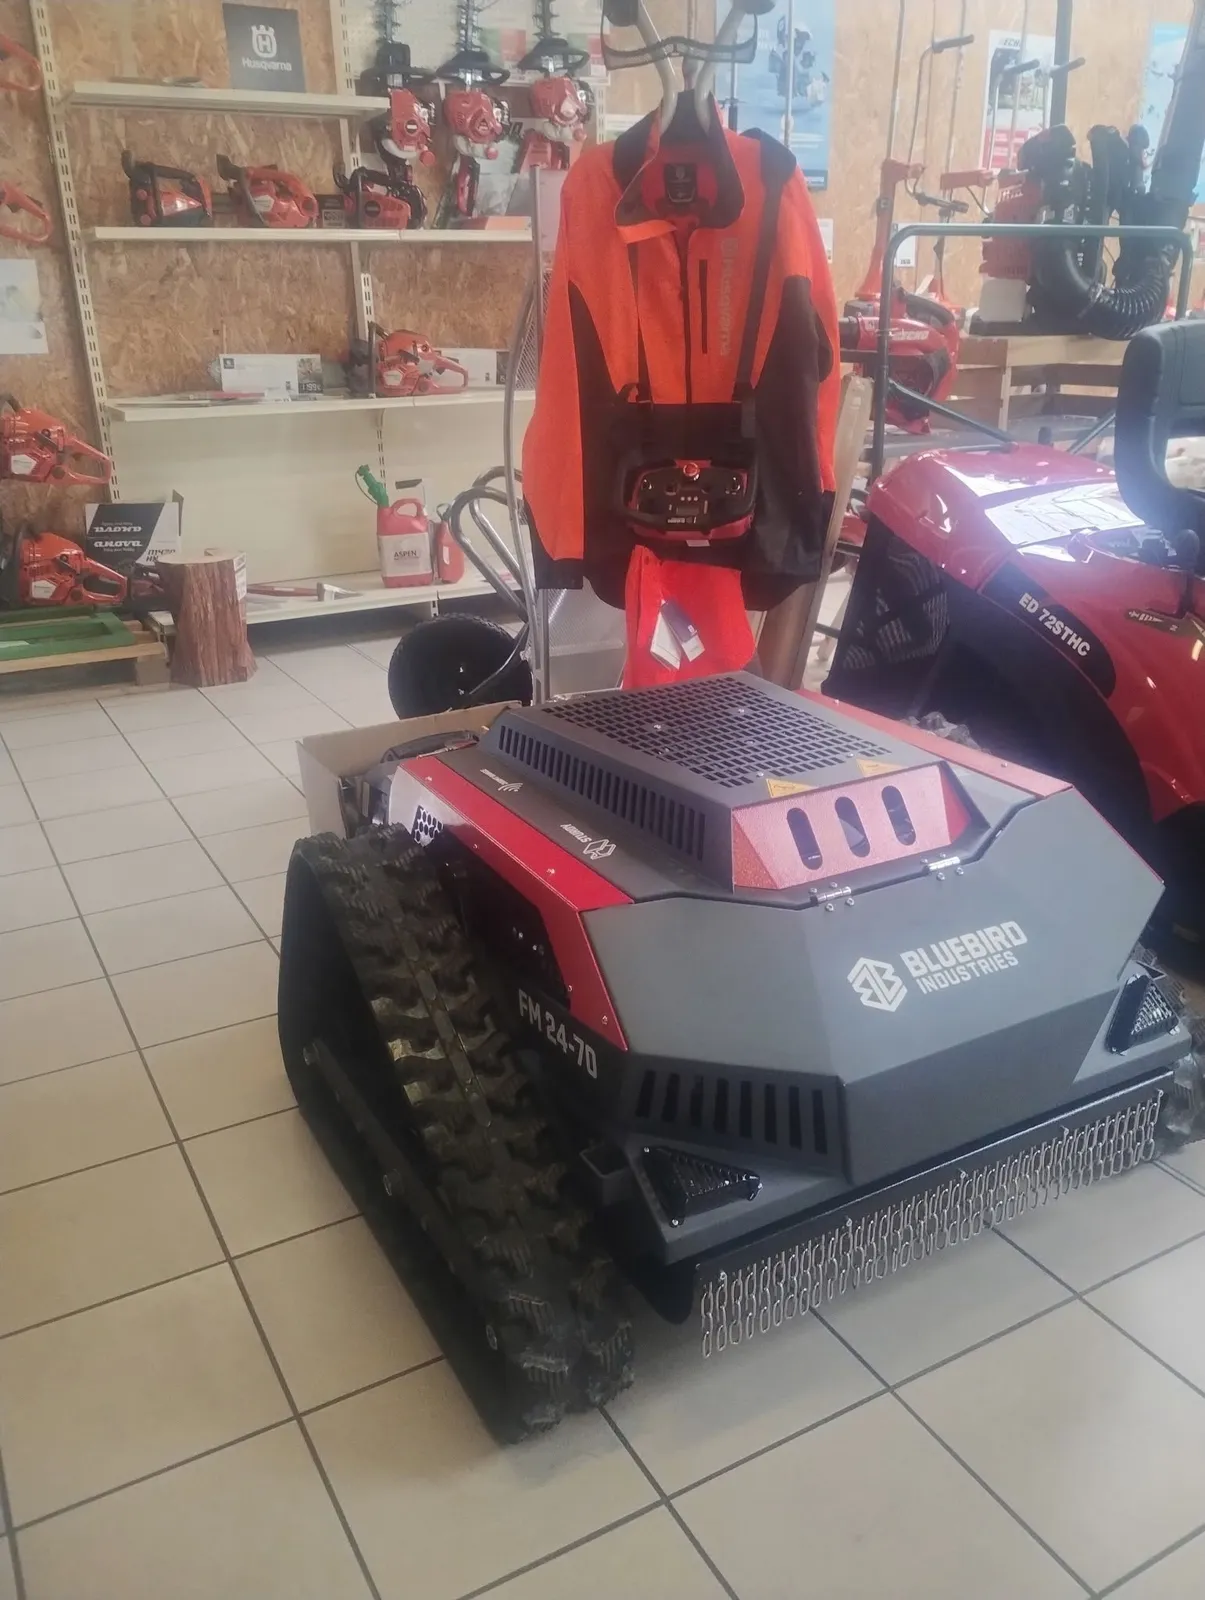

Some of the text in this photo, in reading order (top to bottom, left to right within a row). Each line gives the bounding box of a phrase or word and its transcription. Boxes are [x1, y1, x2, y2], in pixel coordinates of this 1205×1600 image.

[242, 57, 292, 71] Husqvarna
[94, 540, 142, 548] anova
[1019, 592, 1091, 656] ED 72STHC
[900, 921, 1028, 977] BLUEBIRD
[916, 951, 1019, 994] INDUSTRIES
[518, 988, 597, 1079] FM 24-70
